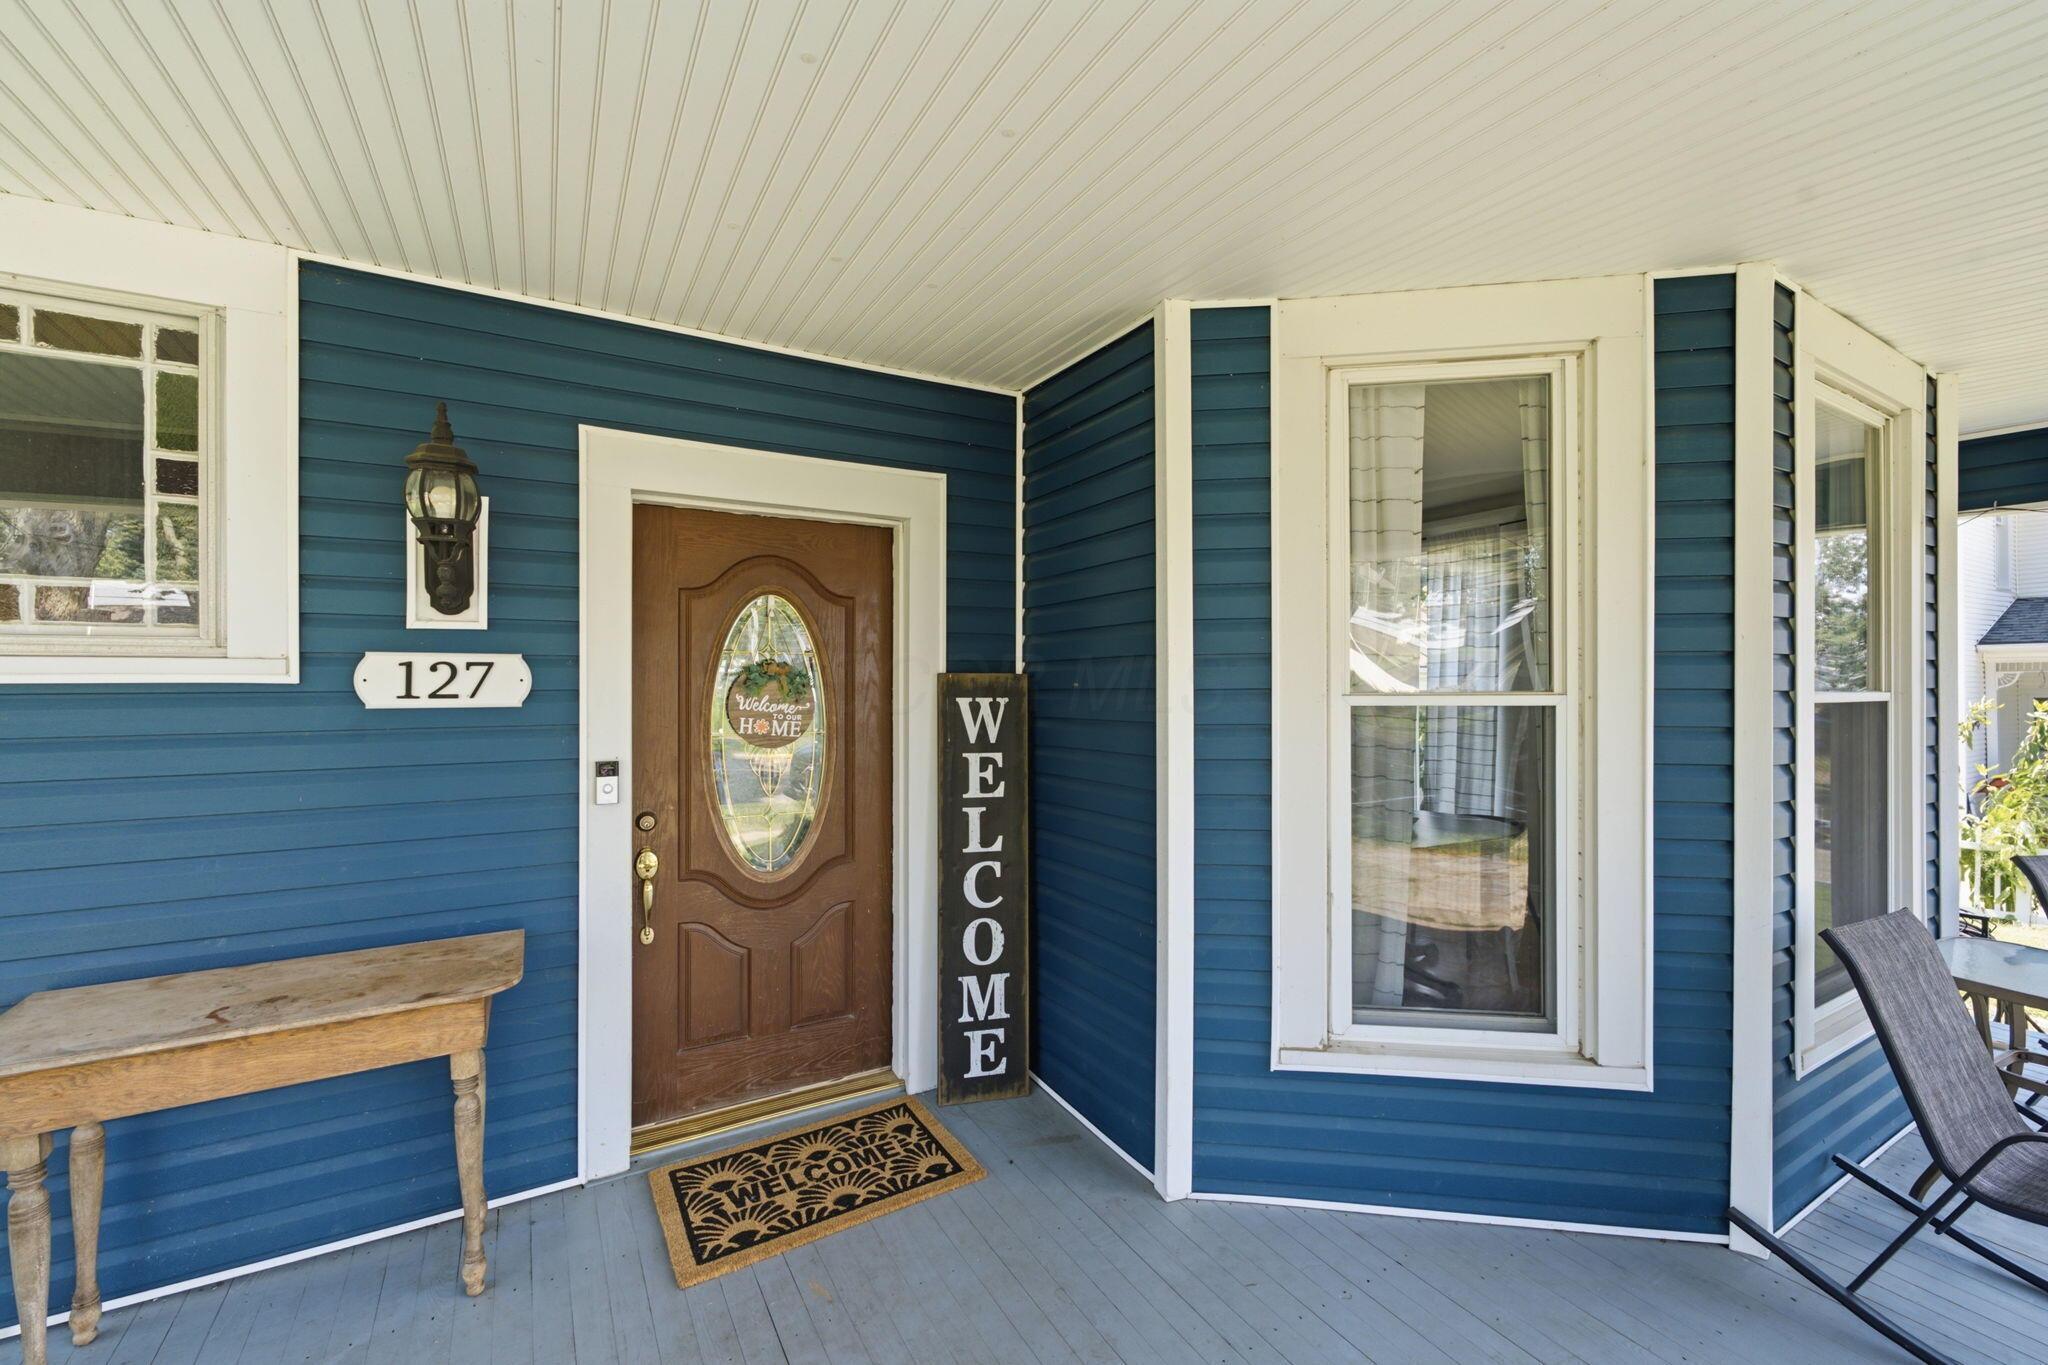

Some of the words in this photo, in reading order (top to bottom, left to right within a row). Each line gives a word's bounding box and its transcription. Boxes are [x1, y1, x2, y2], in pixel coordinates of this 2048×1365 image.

[396, 661, 495, 699] 127
[735, 693, 811, 713] Welcome
[955, 697, 1011, 1079] WELCOME
[725, 1139, 901, 1208] WELCOME
